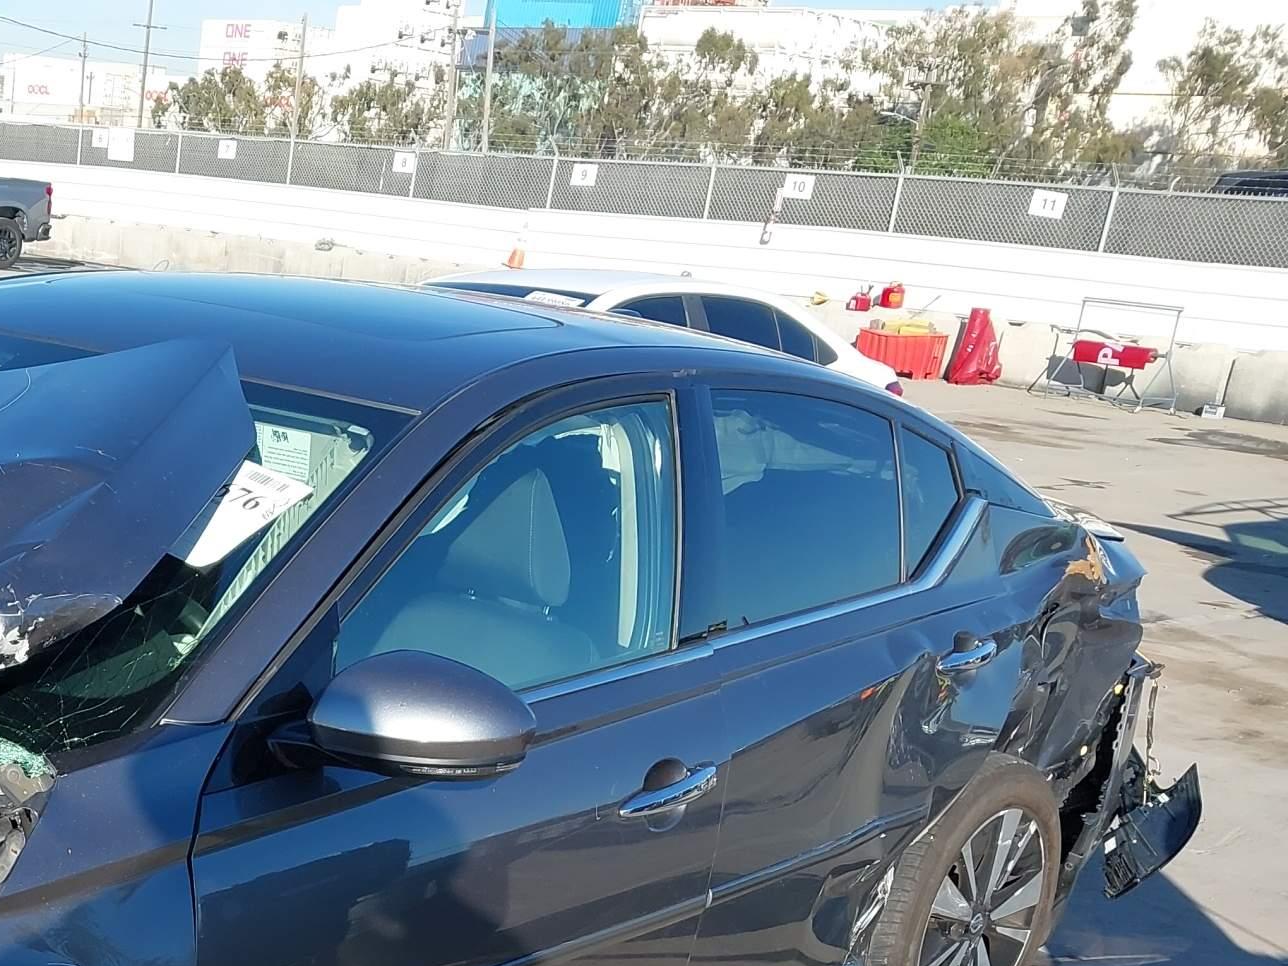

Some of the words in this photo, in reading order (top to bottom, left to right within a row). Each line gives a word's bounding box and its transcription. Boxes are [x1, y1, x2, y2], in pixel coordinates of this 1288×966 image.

[225, 23, 252, 39] ONE
[222, 51, 249, 66] ONE
[402, 158, 408, 167] 8
[581, 169, 588, 180] 9
[793, 181, 806, 193] 10
[1043, 199, 1057, 211] 11
